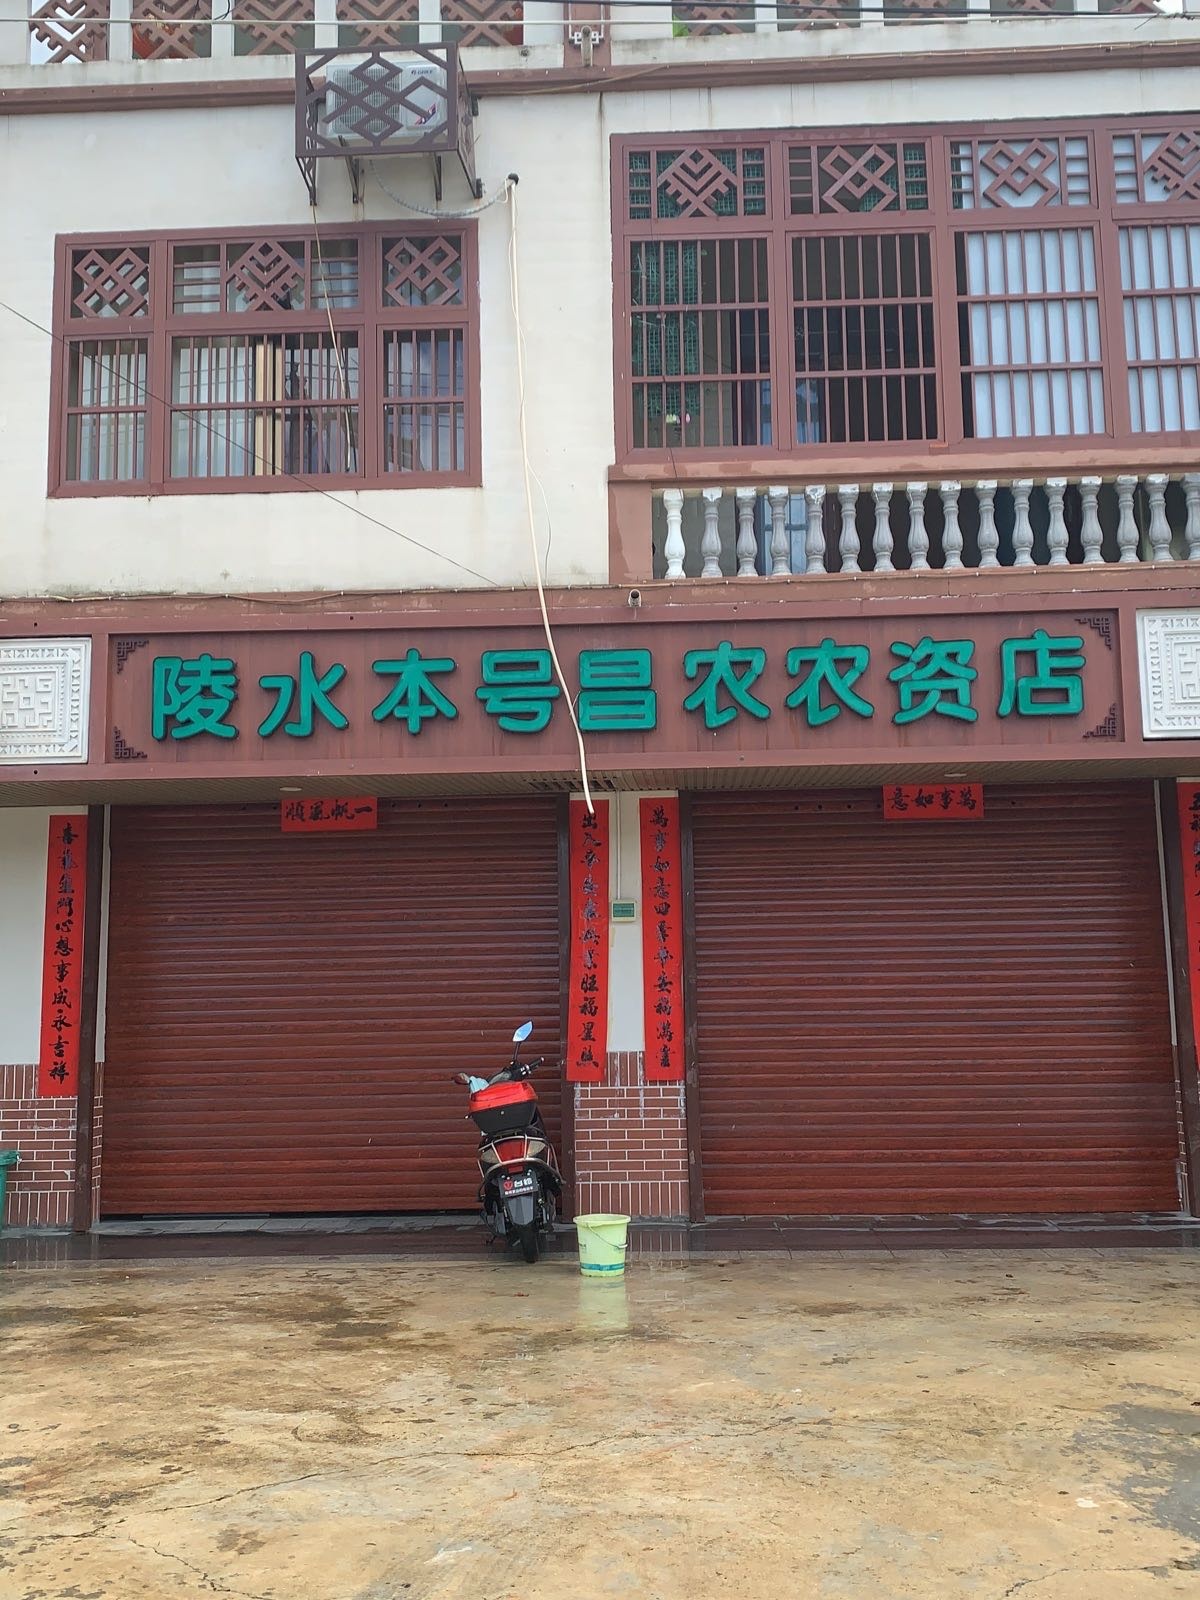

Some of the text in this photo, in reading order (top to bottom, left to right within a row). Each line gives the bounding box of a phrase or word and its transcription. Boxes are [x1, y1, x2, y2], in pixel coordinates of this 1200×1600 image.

[151, 629, 1086, 742] 陵水本号昌农农资店
